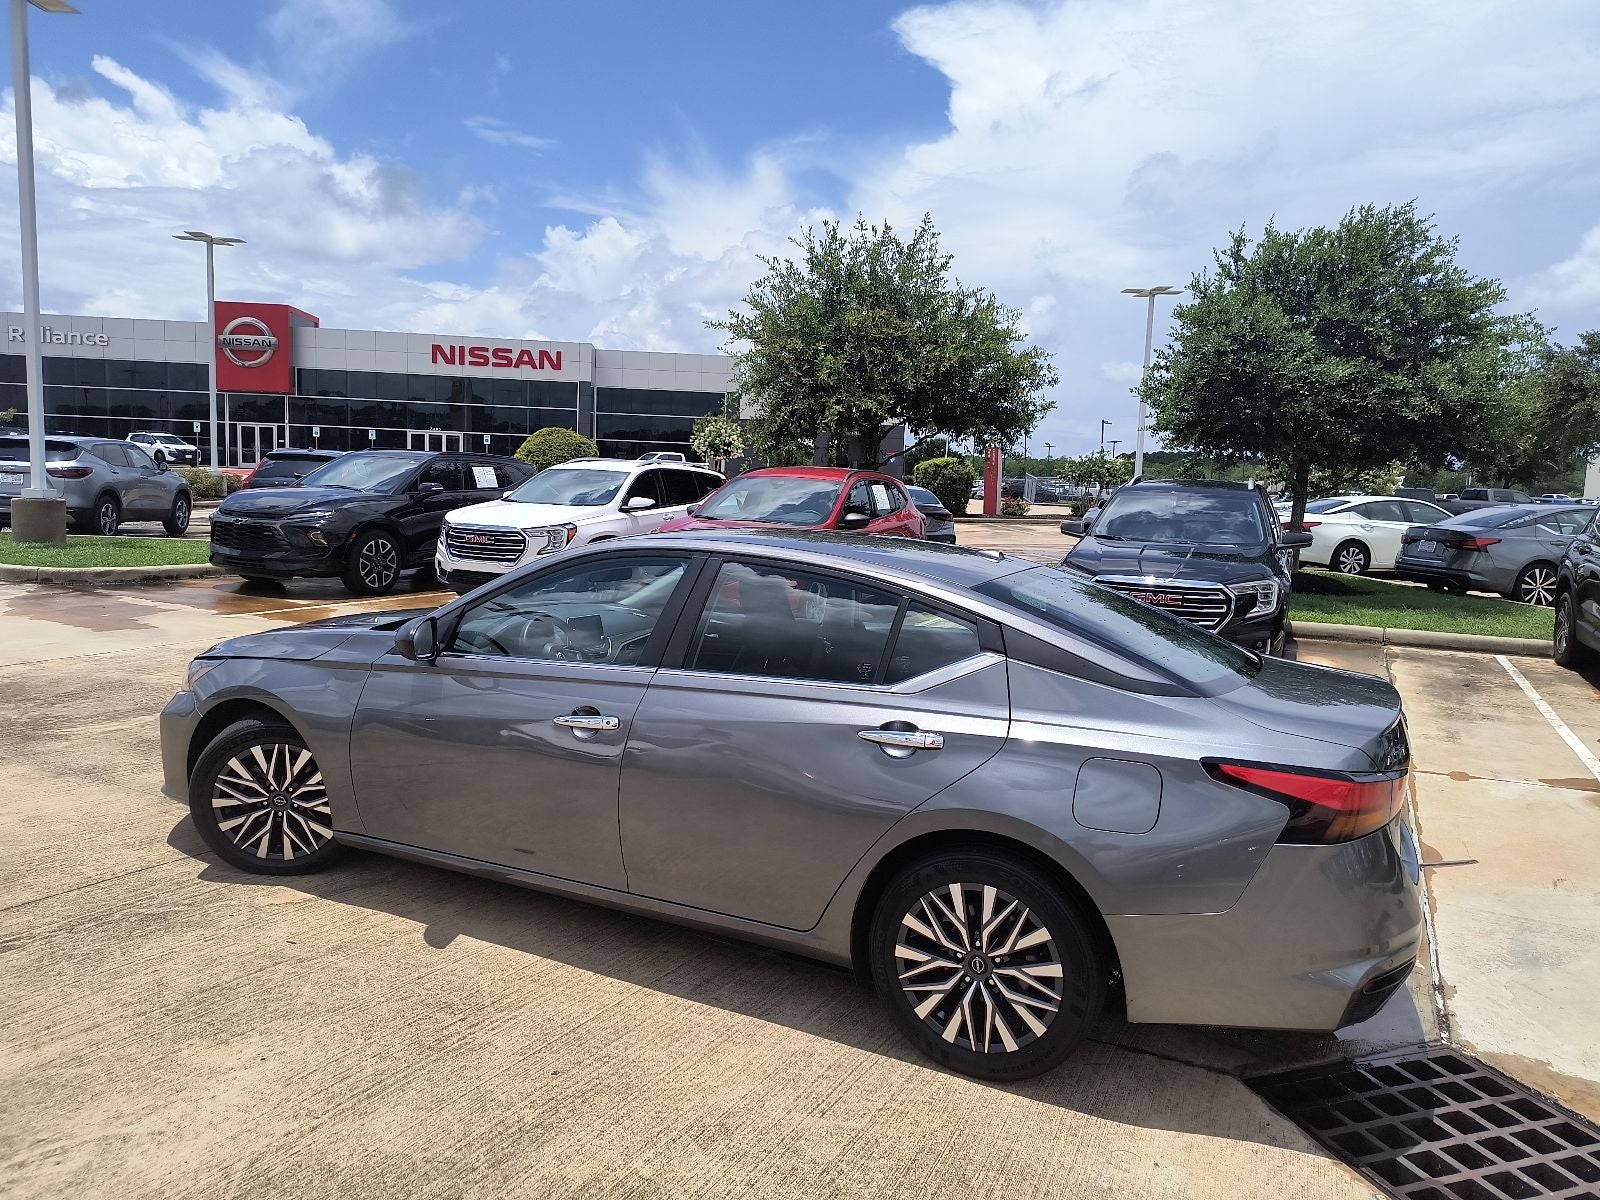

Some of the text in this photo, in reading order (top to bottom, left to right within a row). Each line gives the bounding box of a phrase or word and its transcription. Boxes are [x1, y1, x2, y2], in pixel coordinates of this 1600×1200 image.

[8, 325, 109, 346] Rliance
[222, 337, 272, 348] NISSAN
[431, 343, 562, 370] NISSAN
[465, 534, 495, 544] GMC
[1129, 591, 1183, 606] GMC
